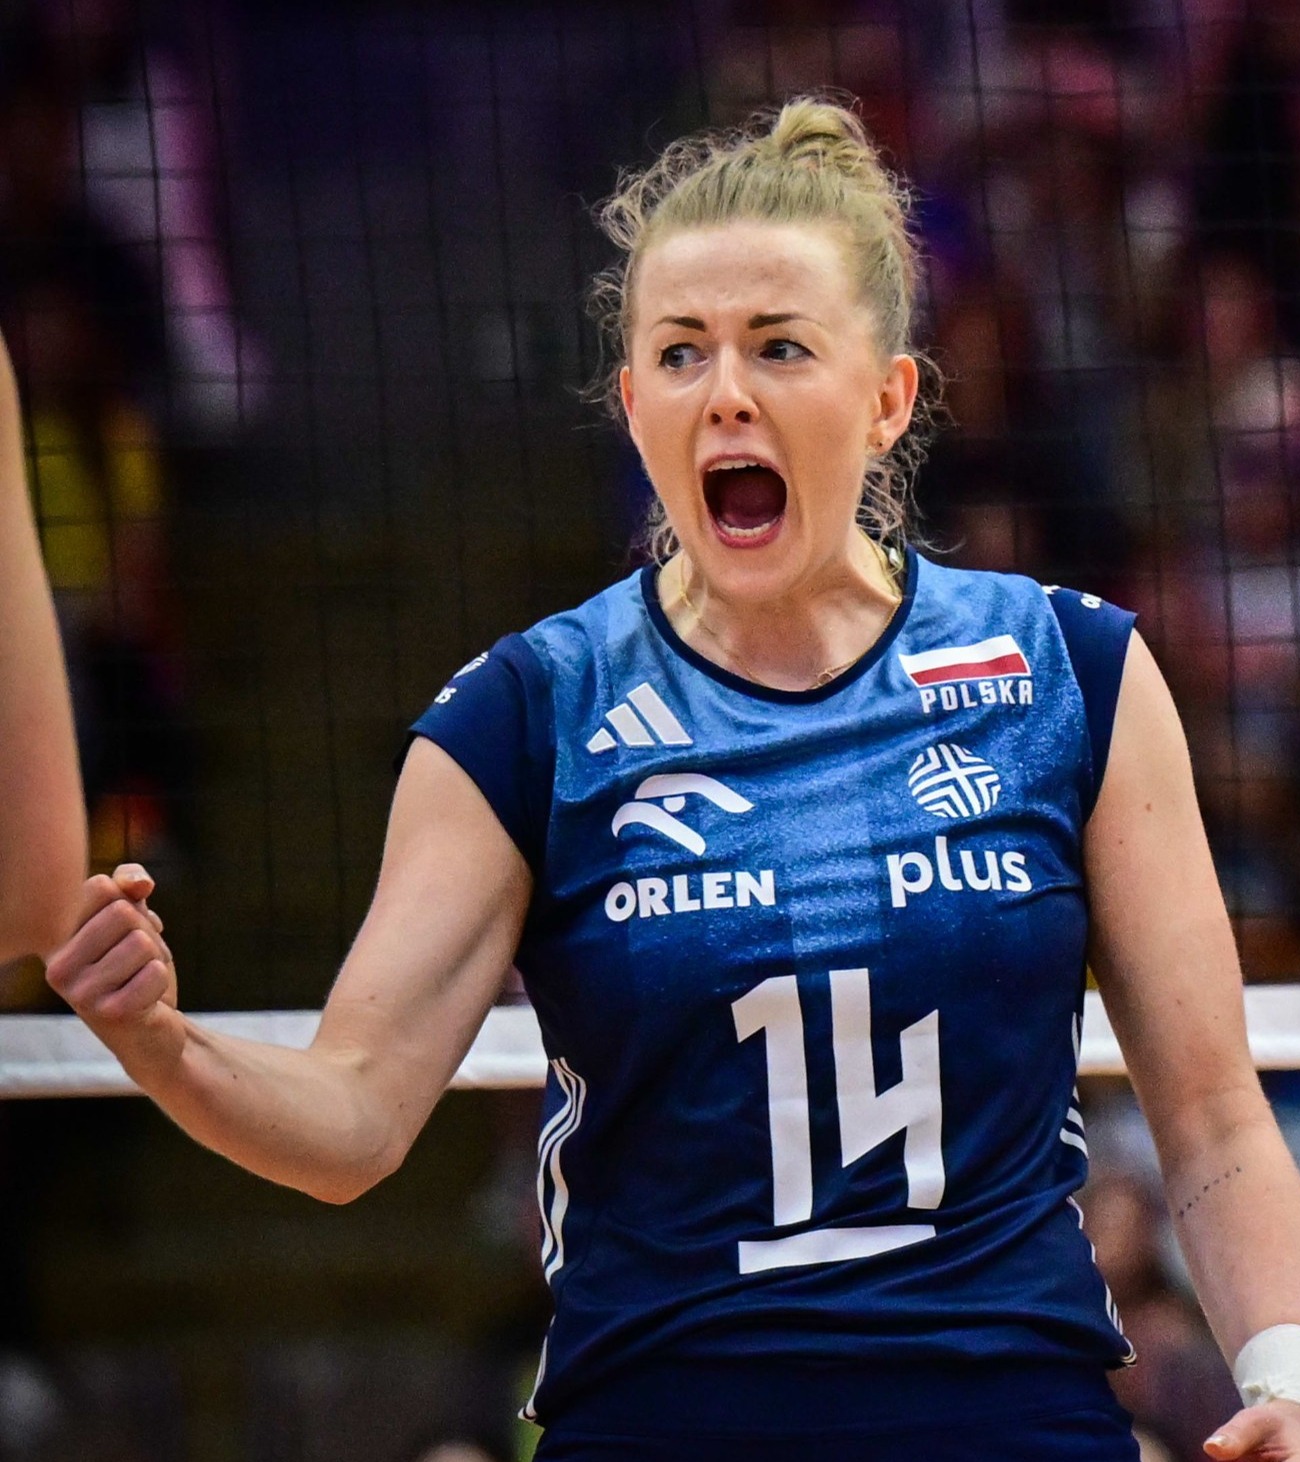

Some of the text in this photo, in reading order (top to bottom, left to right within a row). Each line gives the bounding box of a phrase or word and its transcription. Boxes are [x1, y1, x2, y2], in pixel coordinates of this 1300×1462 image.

[919, 679, 1033, 714] POLSKA
[604, 869, 776, 922] ORLEN
[887, 835, 1033, 908] plus
[731, 967, 946, 1227] 14
